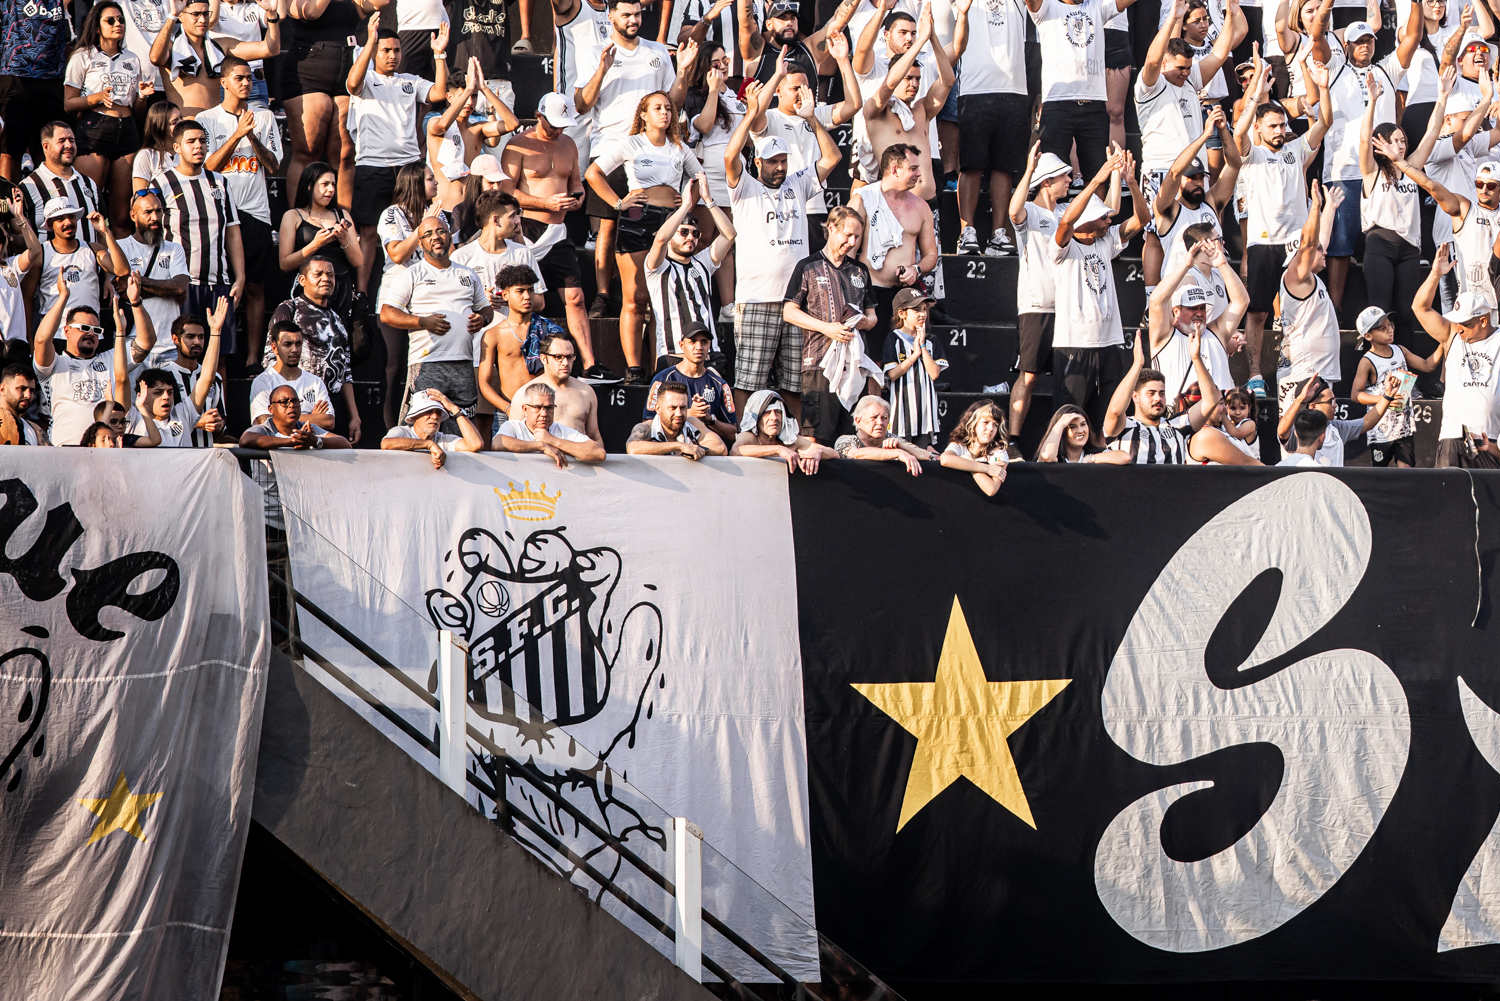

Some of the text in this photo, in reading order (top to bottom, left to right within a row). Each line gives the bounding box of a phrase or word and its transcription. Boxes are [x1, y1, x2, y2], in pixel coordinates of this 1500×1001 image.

[824, 190, 842, 207] 21
[966, 260, 987, 279] 22
[950, 328, 968, 347] 21
[609, 388, 626, 406] 16
[1412, 404, 1432, 423] 26
